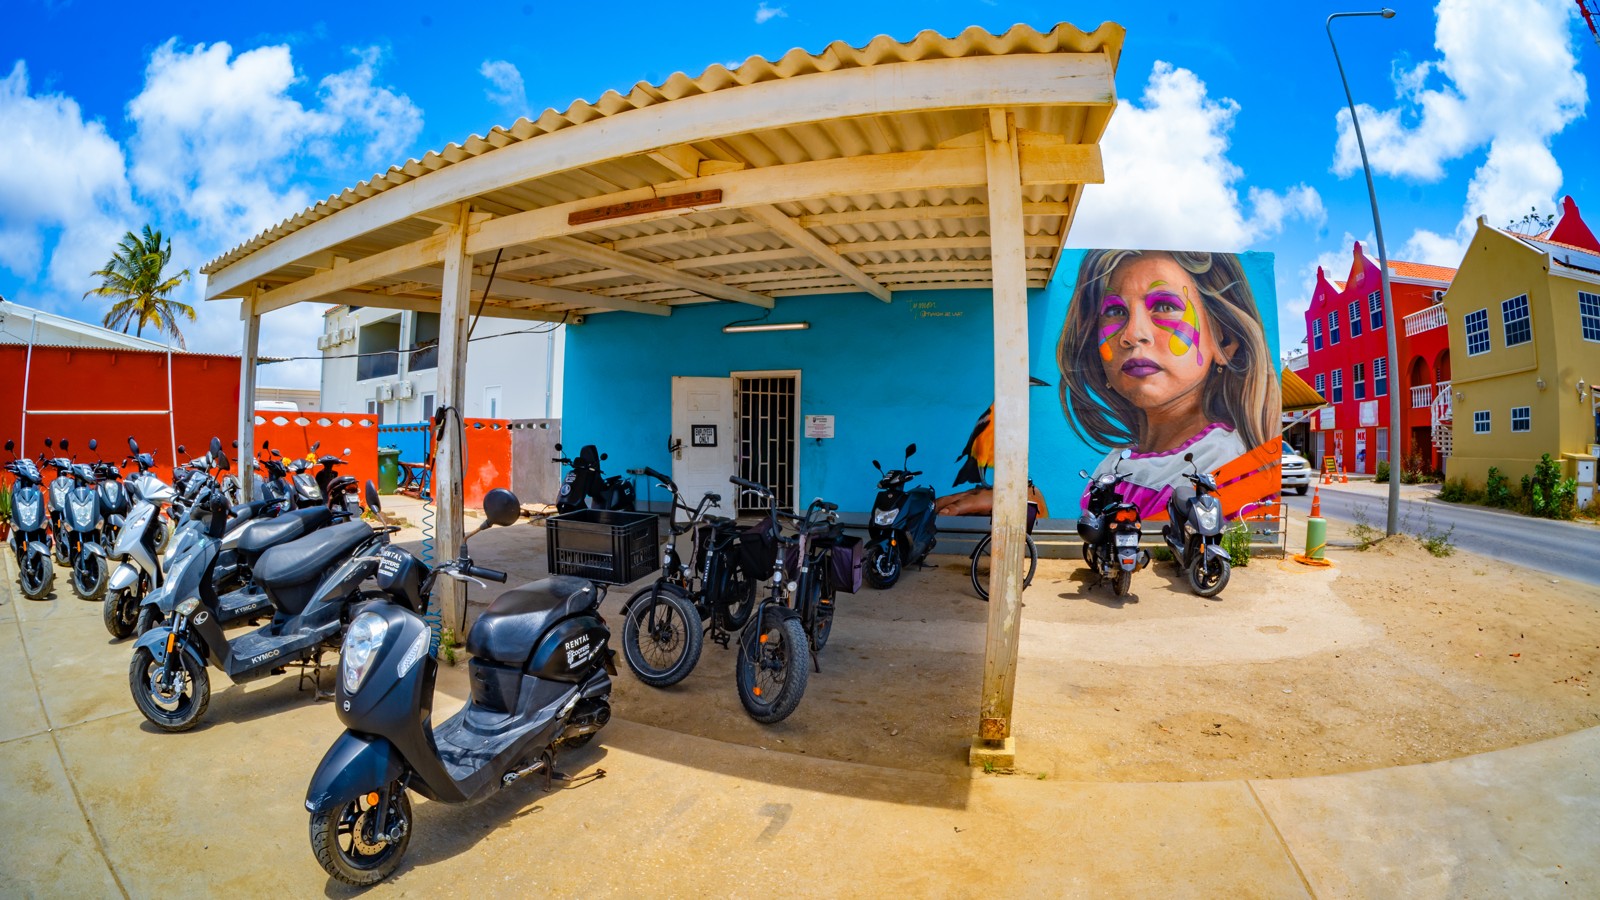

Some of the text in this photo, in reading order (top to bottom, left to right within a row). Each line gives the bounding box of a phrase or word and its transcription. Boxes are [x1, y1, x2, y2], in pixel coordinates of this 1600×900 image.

[699, 436, 710, 444] ONLY
[234, 603, 257, 615] KYMCO
[565, 633, 590, 650] RENTAL
[251, 648, 280, 664] KYMCO
